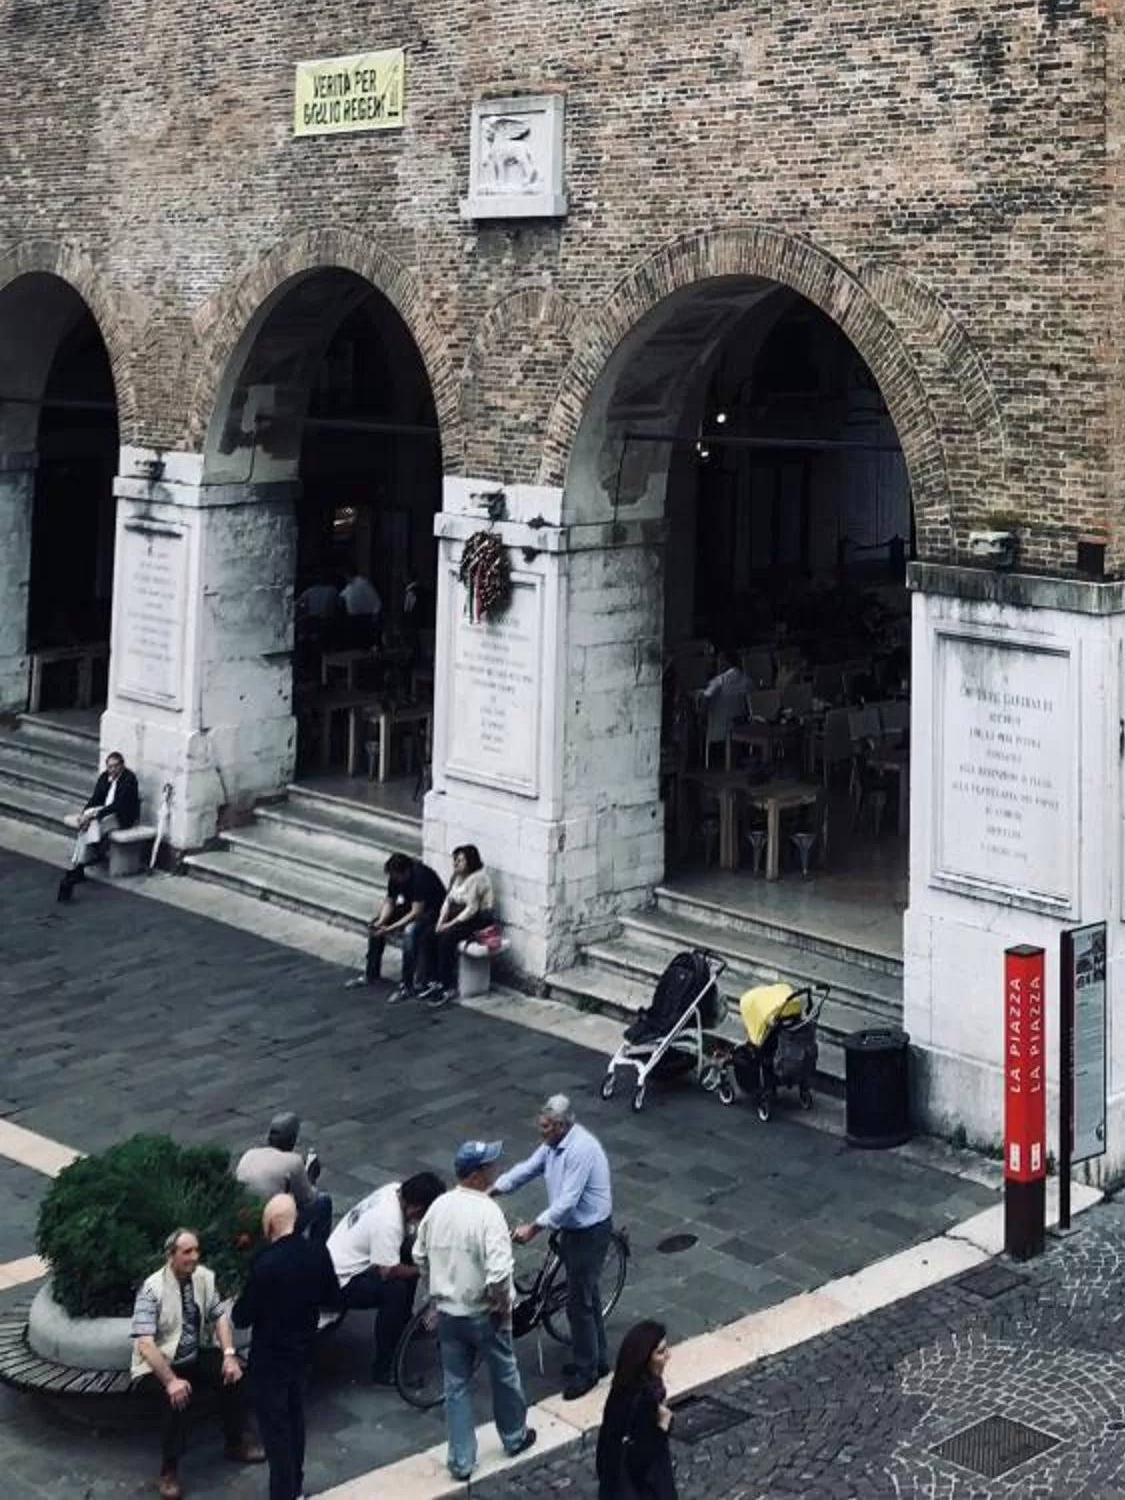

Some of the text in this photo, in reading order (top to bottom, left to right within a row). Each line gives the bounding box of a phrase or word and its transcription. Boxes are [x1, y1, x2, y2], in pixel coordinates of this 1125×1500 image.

[303, 95, 384, 125] GIULIO REGENI
[354, 69, 377, 93] PER
[1009, 978, 1021, 1093] LA PIAZZA
[1030, 976, 1041, 1093] LA PIAZZA
